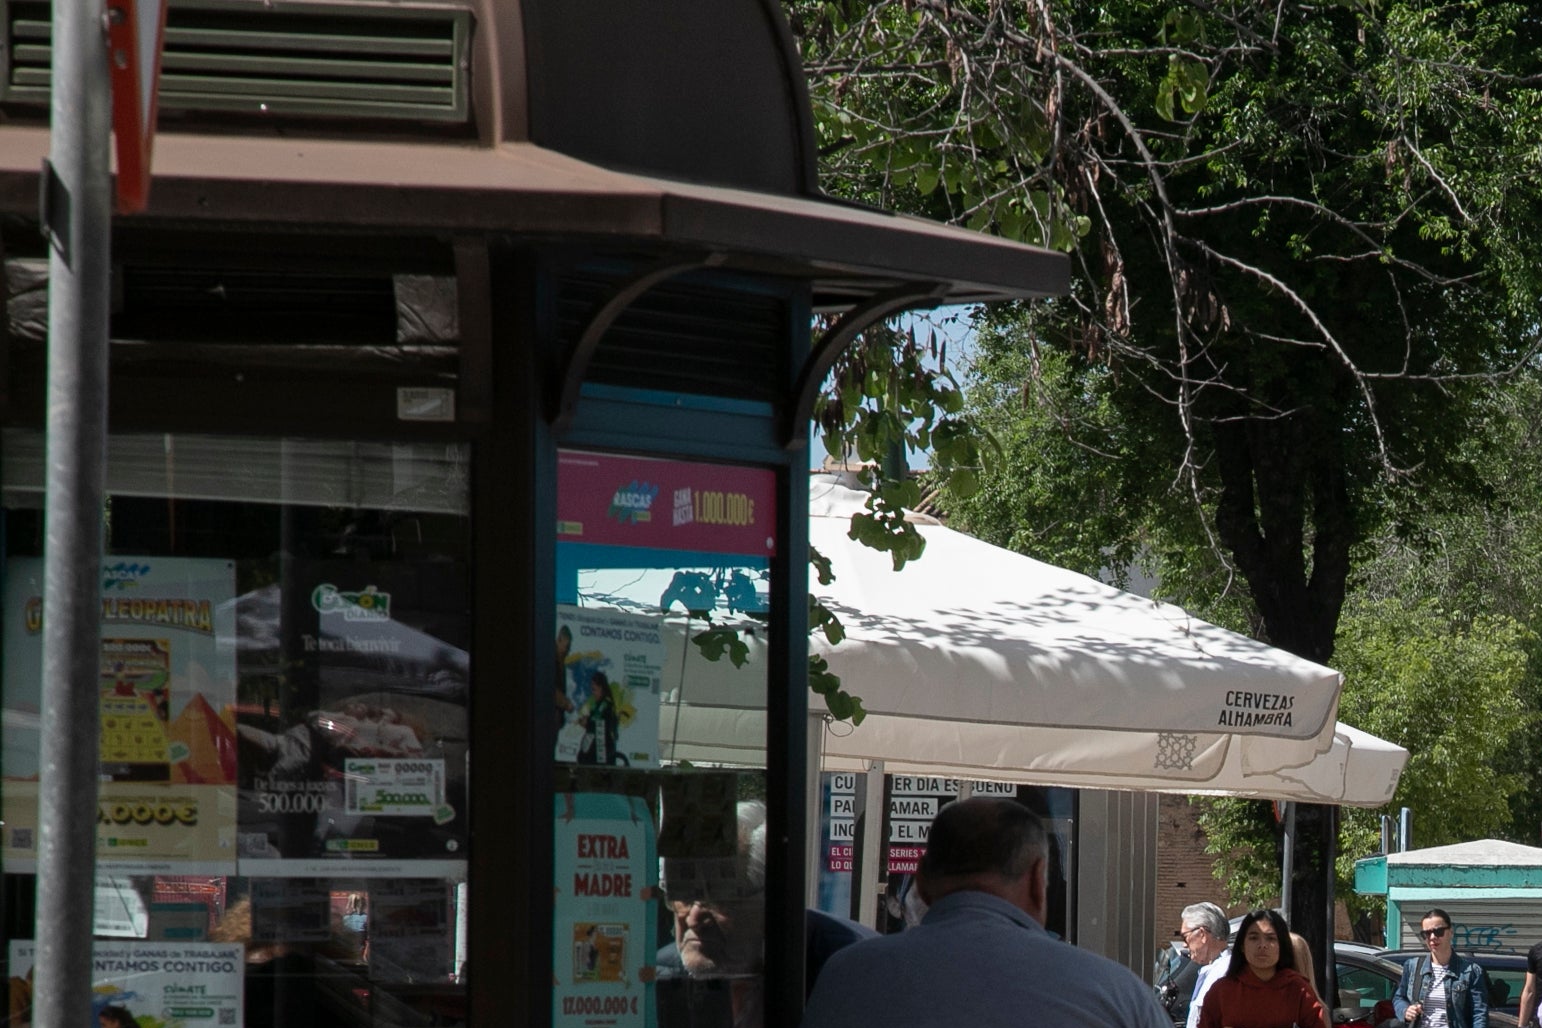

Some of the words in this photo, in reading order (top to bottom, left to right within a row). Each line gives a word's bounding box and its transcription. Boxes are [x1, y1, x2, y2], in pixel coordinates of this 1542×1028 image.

[613, 491, 653, 509] RASCAS
[100, 598, 213, 631] LEOPATRA
[581, 625, 622, 640] CONTAMOS
[1225, 690, 1296, 711] CERVEZAS
[1218, 709, 1293, 728] ALHAMBRA
[898, 825, 914, 838] EL
[577, 833, 630, 859] EXTRA
[889, 848, 919, 858] SERIES
[831, 861, 841, 870] LO
[574, 872, 633, 898] MADRE
[93, 960, 160, 973] NTAMOS
[163, 960, 237, 973] CONTIGO.
